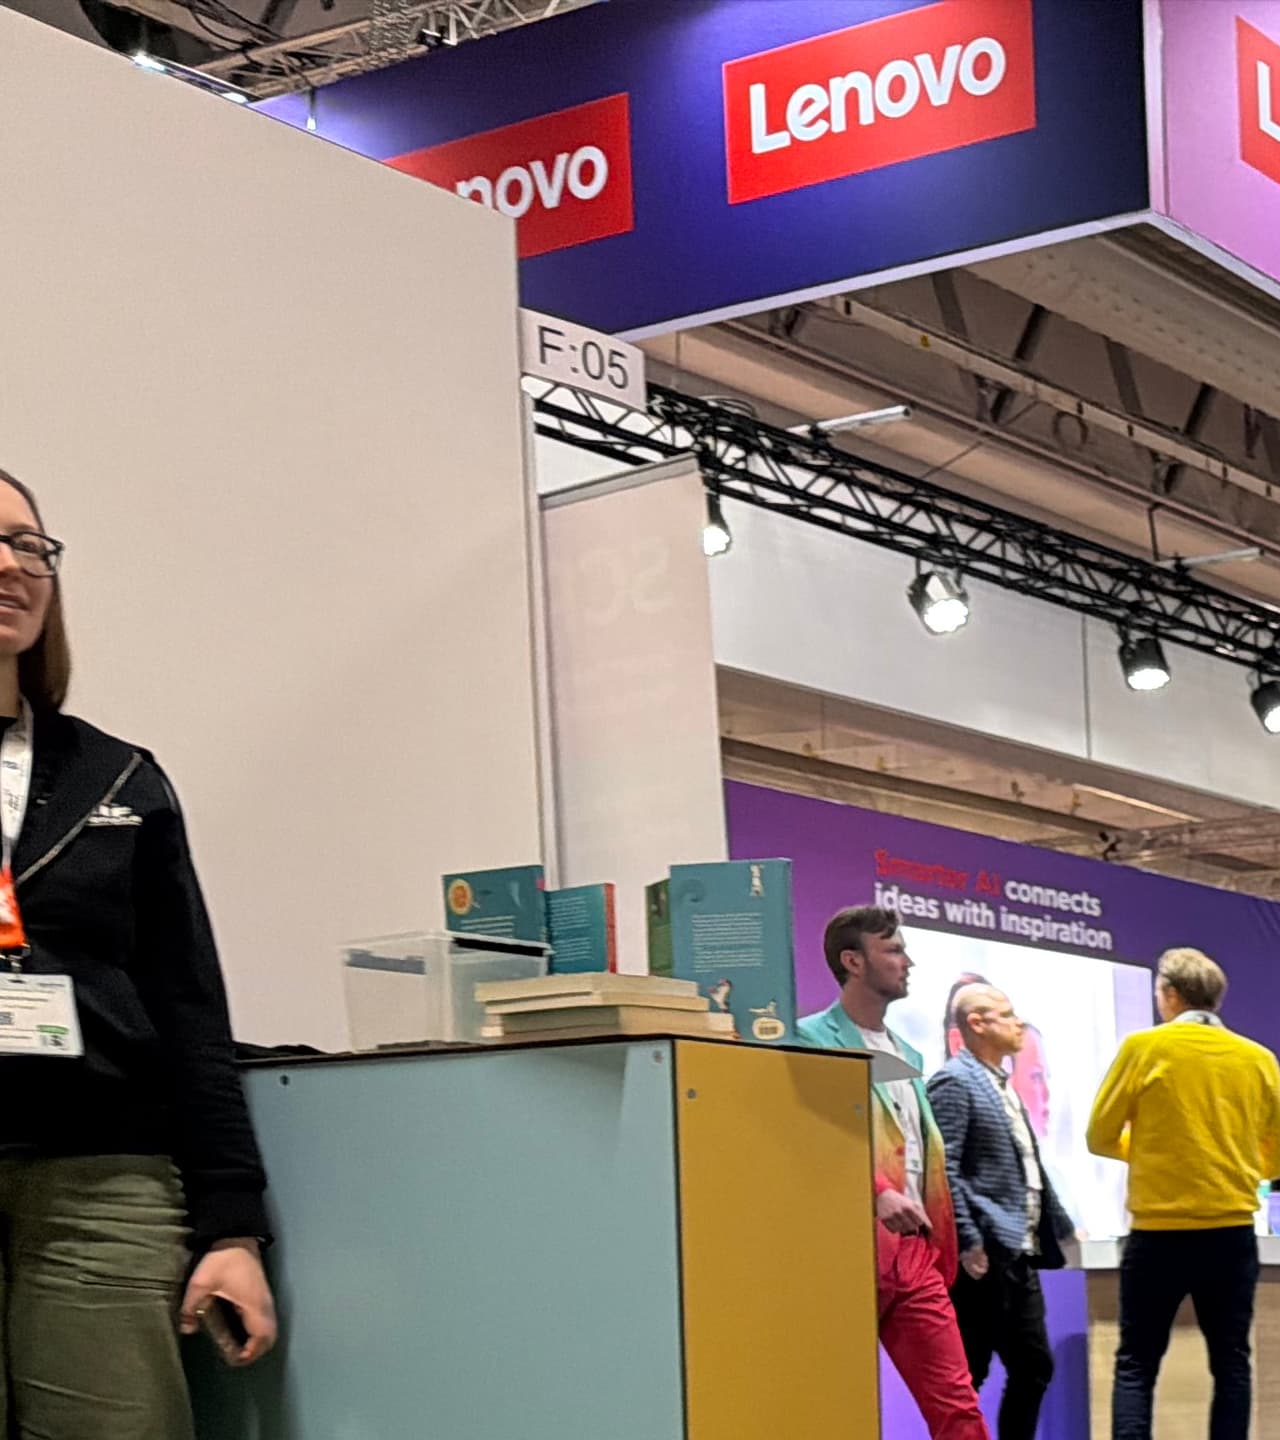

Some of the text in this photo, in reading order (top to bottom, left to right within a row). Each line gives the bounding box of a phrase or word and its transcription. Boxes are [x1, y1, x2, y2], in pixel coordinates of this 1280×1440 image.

[749, 36, 1007, 155] Lenovo
[456, 145, 609, 219] novo
[537, 324, 630, 391] F:05
[873, 881, 1113, 951] ideas with inspiration
[1004, 880, 1101, 917] connects
